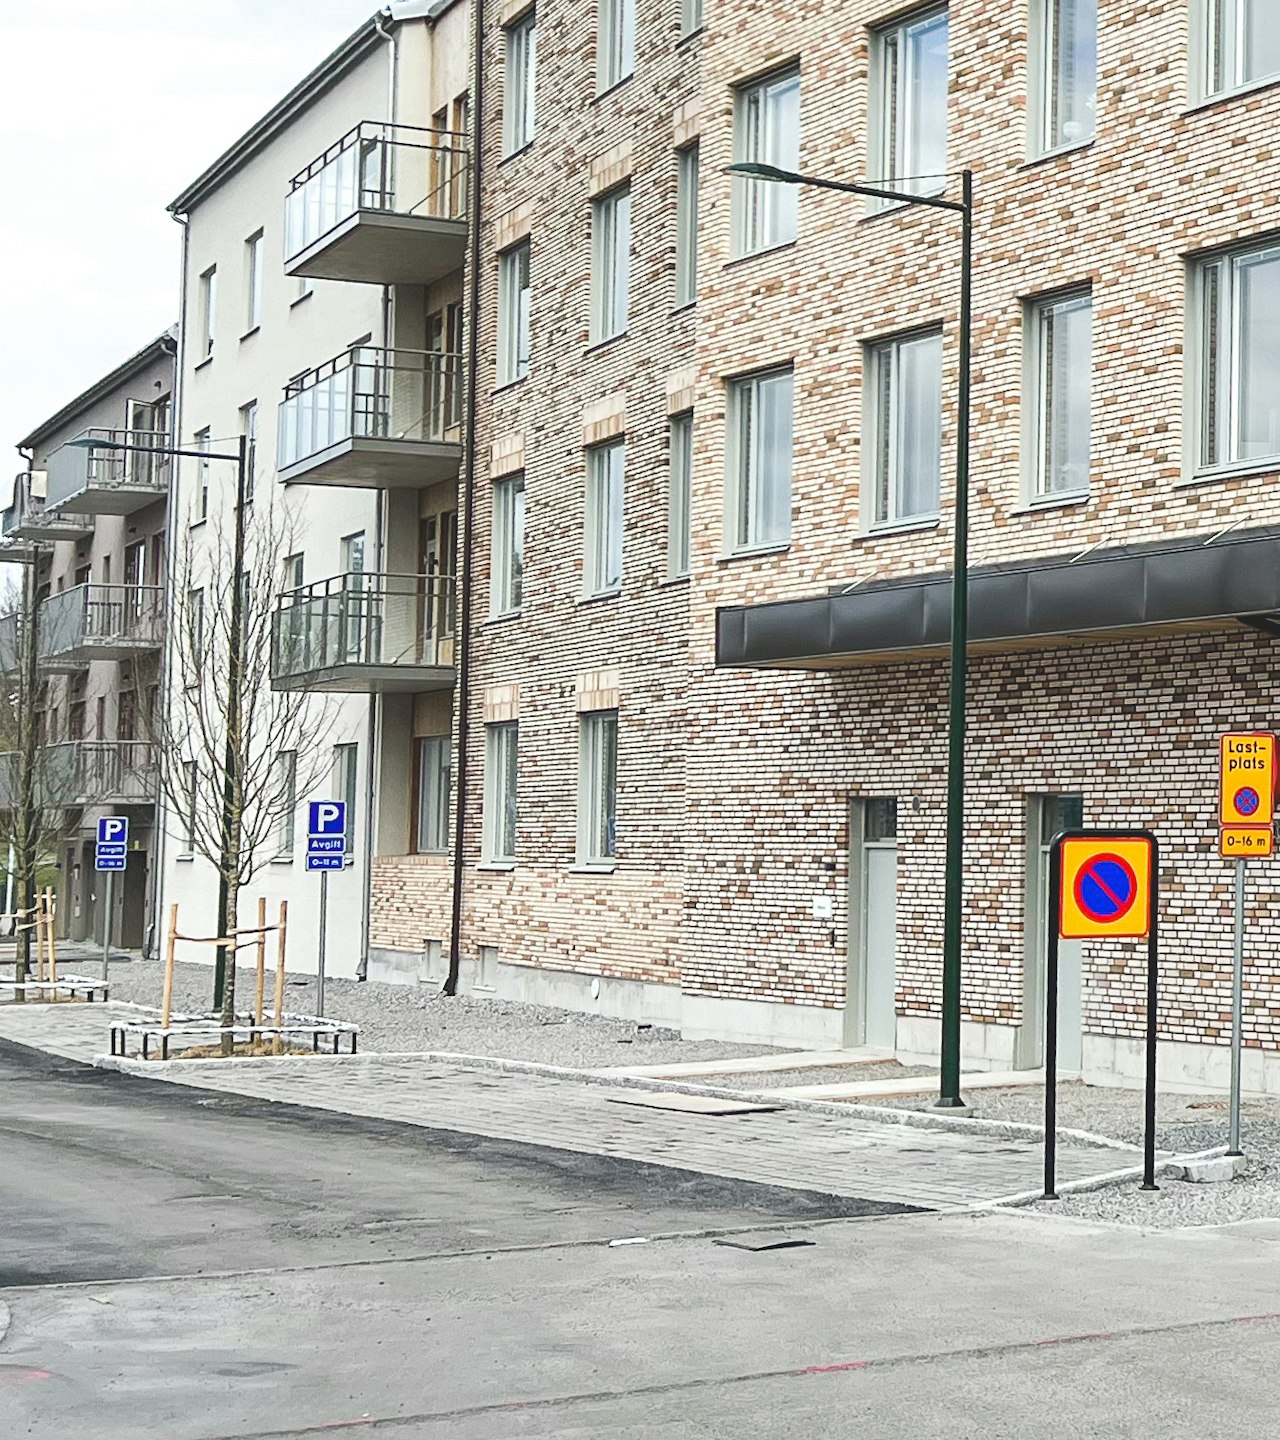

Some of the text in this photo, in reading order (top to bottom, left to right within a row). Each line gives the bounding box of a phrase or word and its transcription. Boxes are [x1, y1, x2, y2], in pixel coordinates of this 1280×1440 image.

[1229, 740, 1266, 753] Last-
[1229, 757, 1265, 772] plats
[318, 804, 339, 832] P
[105, 820, 122, 841] P
[312, 840, 341, 850] Avgift
[1227, 836, 1265, 846] 0-16 m
